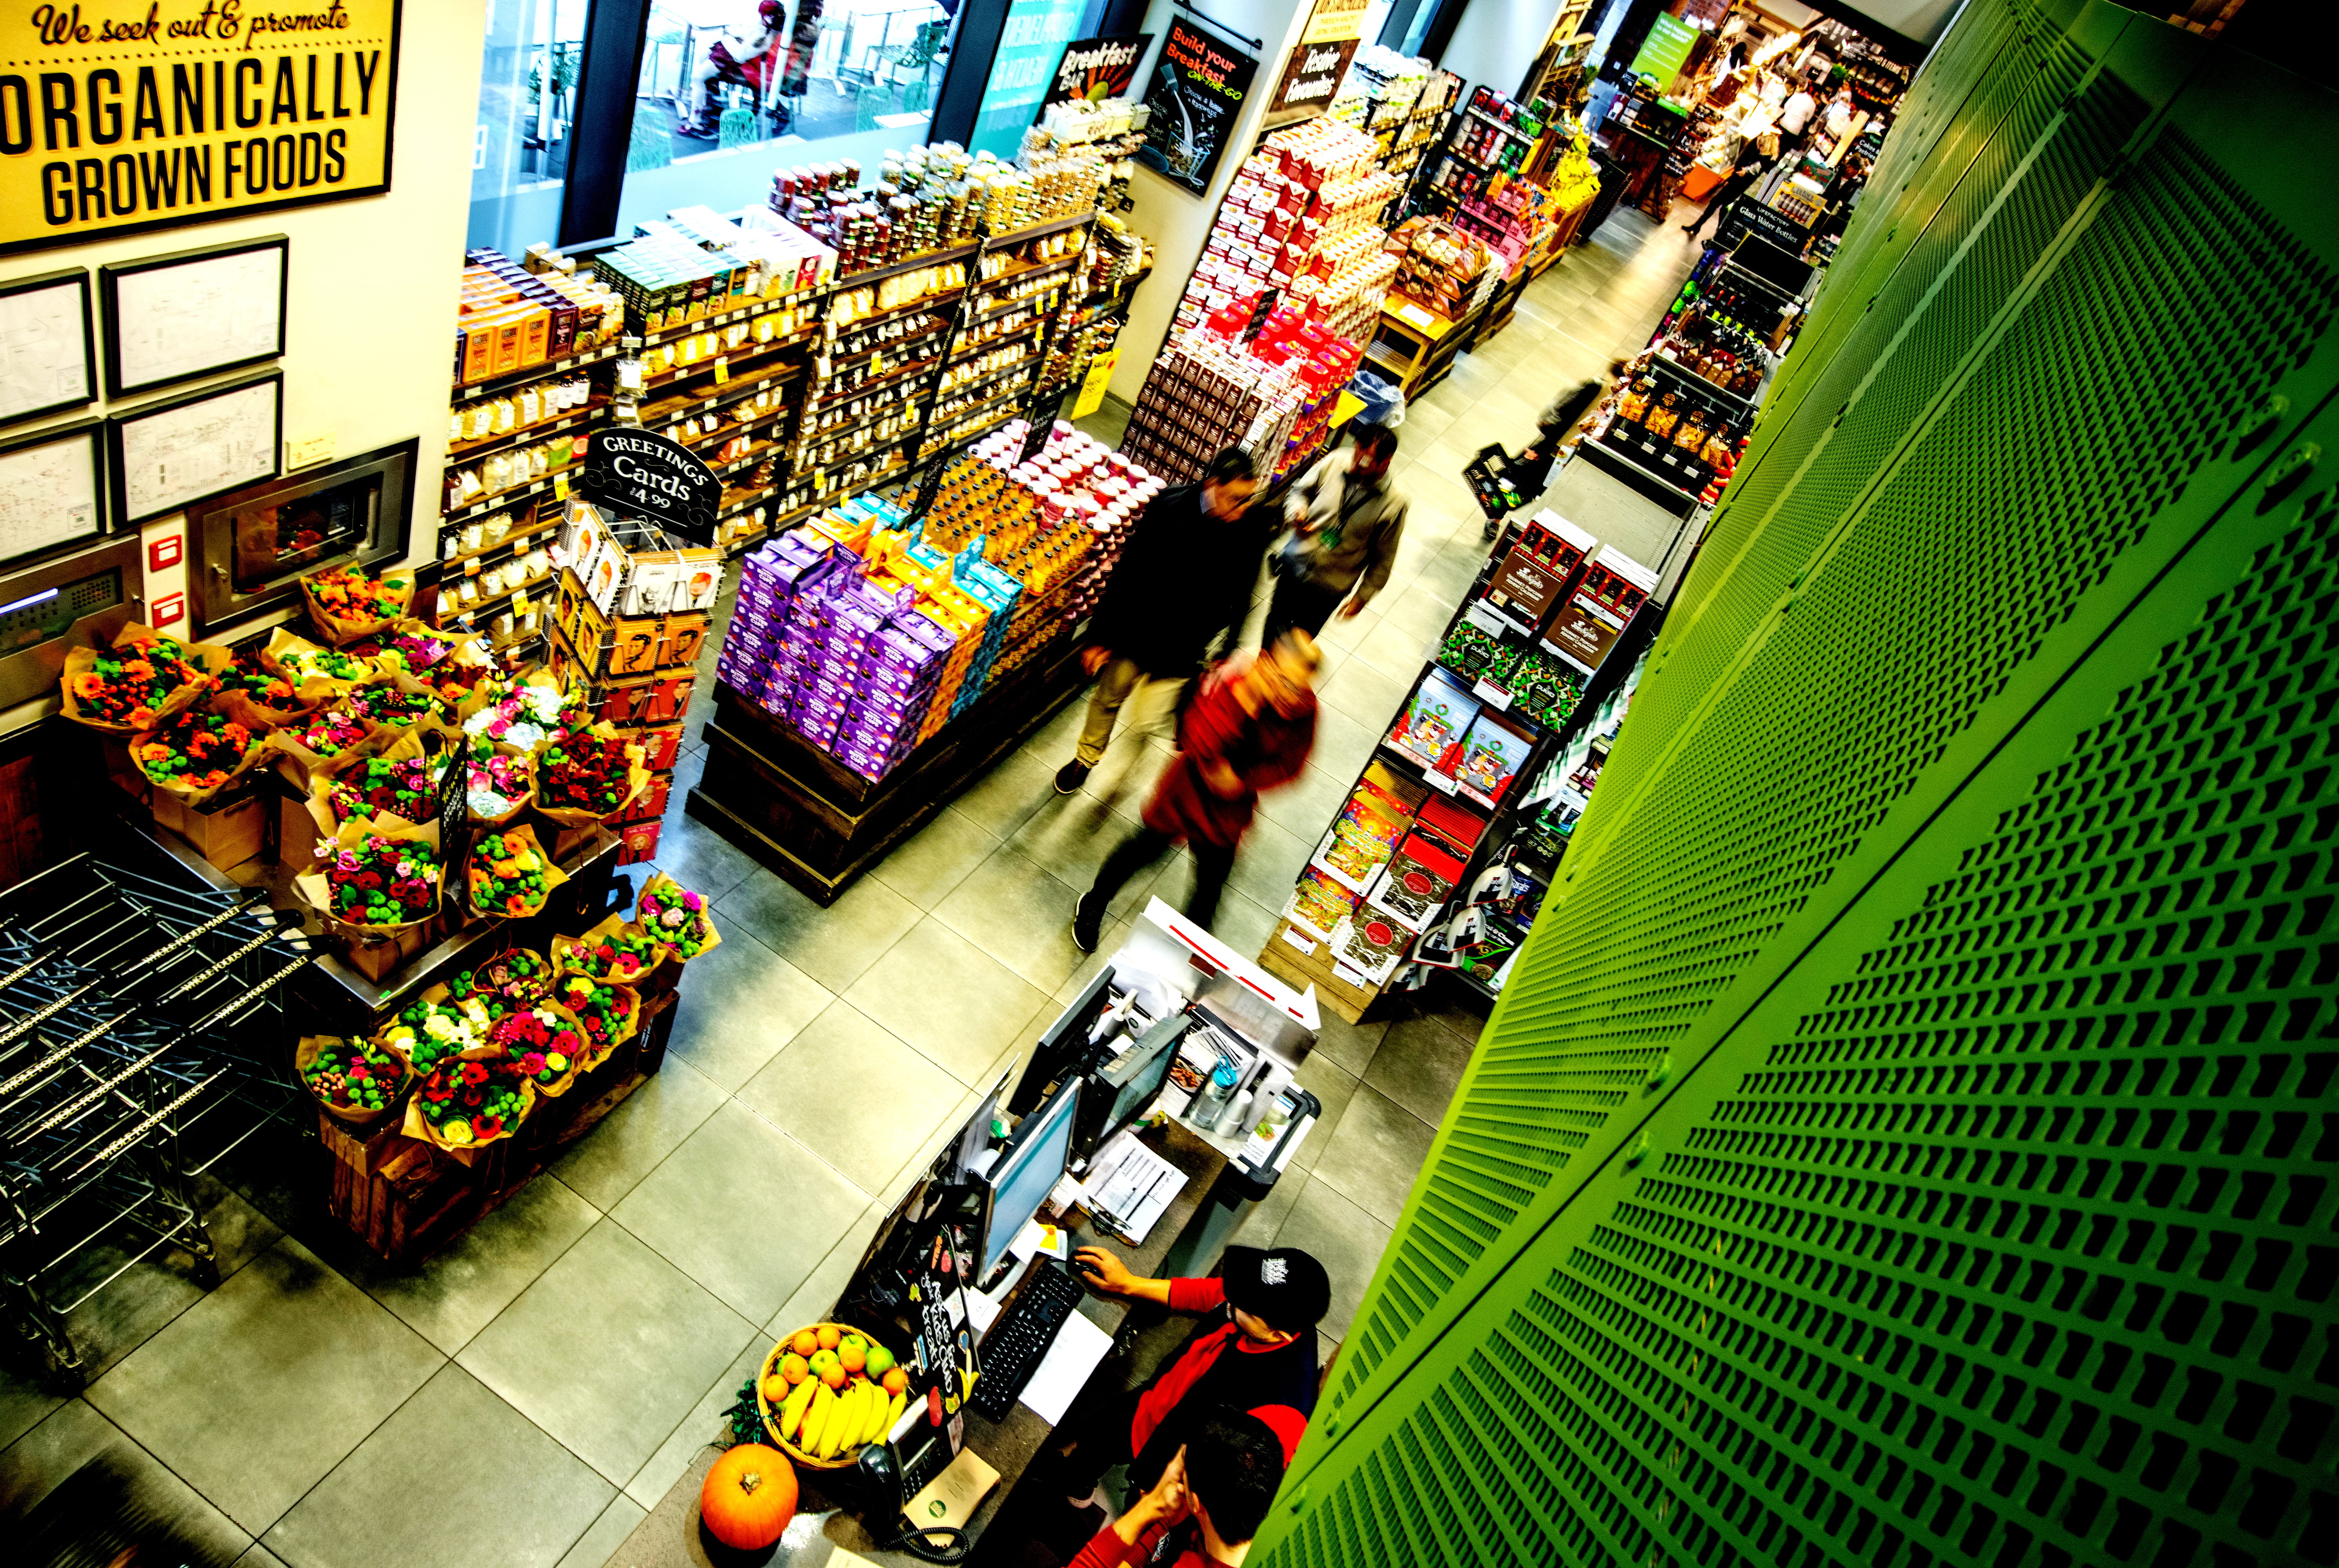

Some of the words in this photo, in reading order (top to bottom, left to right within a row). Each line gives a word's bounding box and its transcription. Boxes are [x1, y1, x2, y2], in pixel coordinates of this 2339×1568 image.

[32, 4, 94, 45] We
[95, 2, 159, 45] seek
[167, 0, 214, 39] out
[217, 0, 242, 39] &
[244, 0, 351, 51] promote
[1173, 26, 1206, 55] Build
[1205, 49, 1236, 73] your
[1058, 41, 1138, 76] Breakfast
[1167, 42, 1225, 84] Breakfast
[1301, 46, 1341, 74] Festive
[1059, 71, 1085, 91] BAR
[1187, 70, 1243, 100] ON-THE-GO
[1284, 73, 1335, 103] Favourites
[0, 50, 381, 155] ORGANICALLY
[1855, 145, 1876, 160] Pastries
[1859, 139, 1876, 152] Cakes
[42, 143, 211, 226] GROWN
[224, 129, 347, 199] FOODS
[1740, 206, 1756, 220] Glass
[1757, 215, 1776, 230] Water
[603, 437, 709, 486] GREETINGS
[614, 456, 691, 501] Cards
[757, 568, 777, 583] BUTTER
[758, 573, 774, 585] CUPS
[1506, 578, 1521, 590] ADVENT
[1520, 587, 1539, 601] CALENDAR
[1507, 573, 1526, 587] GOURMET
[1525, 585, 1544, 599] POPCORN
[753, 590, 773, 606] BUTTER
[754, 597, 769, 608] CUPS
[748, 612, 769, 627] BUTTER
[750, 618, 765, 629] CUPS
[835, 615, 855, 630] BUTTER
[836, 621, 851, 633] CUPS
[742, 631, 762, 647] BUTTER
[744, 637, 758, 648] CUPS
[829, 637, 849, 652] BUTTER
[1560, 631, 1576, 642] ADVENT
[1575, 640, 1595, 654] CALENDAR
[1561, 626, 1580, 640] GOURMET
[1579, 637, 1599, 651] POPCORN
[830, 643, 845, 655] CUPS
[884, 645, 904, 661] BUTTER
[1470, 645, 1490, 659] pukka
[736, 650, 755, 665] BUTTER
[738, 655, 751, 666] CUPS
[885, 652, 900, 663] CUPS
[824, 659, 845, 674] BUTTER
[826, 665, 841, 676] CUPS
[876, 666, 896, 682] BUTTER
[730, 668, 749, 684] BUTTER
[732, 674, 745, 685] CUPS
[877, 673, 892, 684] CUPS
[817, 678, 836, 693] BUTTER
[818, 684, 832, 695] CUPS
[1536, 684, 1556, 698] pukka
[871, 688, 892, 704] BUTTER
[873, 695, 888, 706] CUPS
[809, 698, 828, 713] BUTTER
[811, 703, 824, 715] CUPS
[803, 717, 821, 732] BUTTER
[863, 710, 883, 725] BUTTER
[864, 716, 879, 728] CUPS
[804, 723, 818, 734] CUPS
[856, 730, 875, 744] BUTTER
[857, 735, 872, 747] CUPS
[849, 749, 869, 764] BUTTER
[850, 755, 865, 766] CUPS
